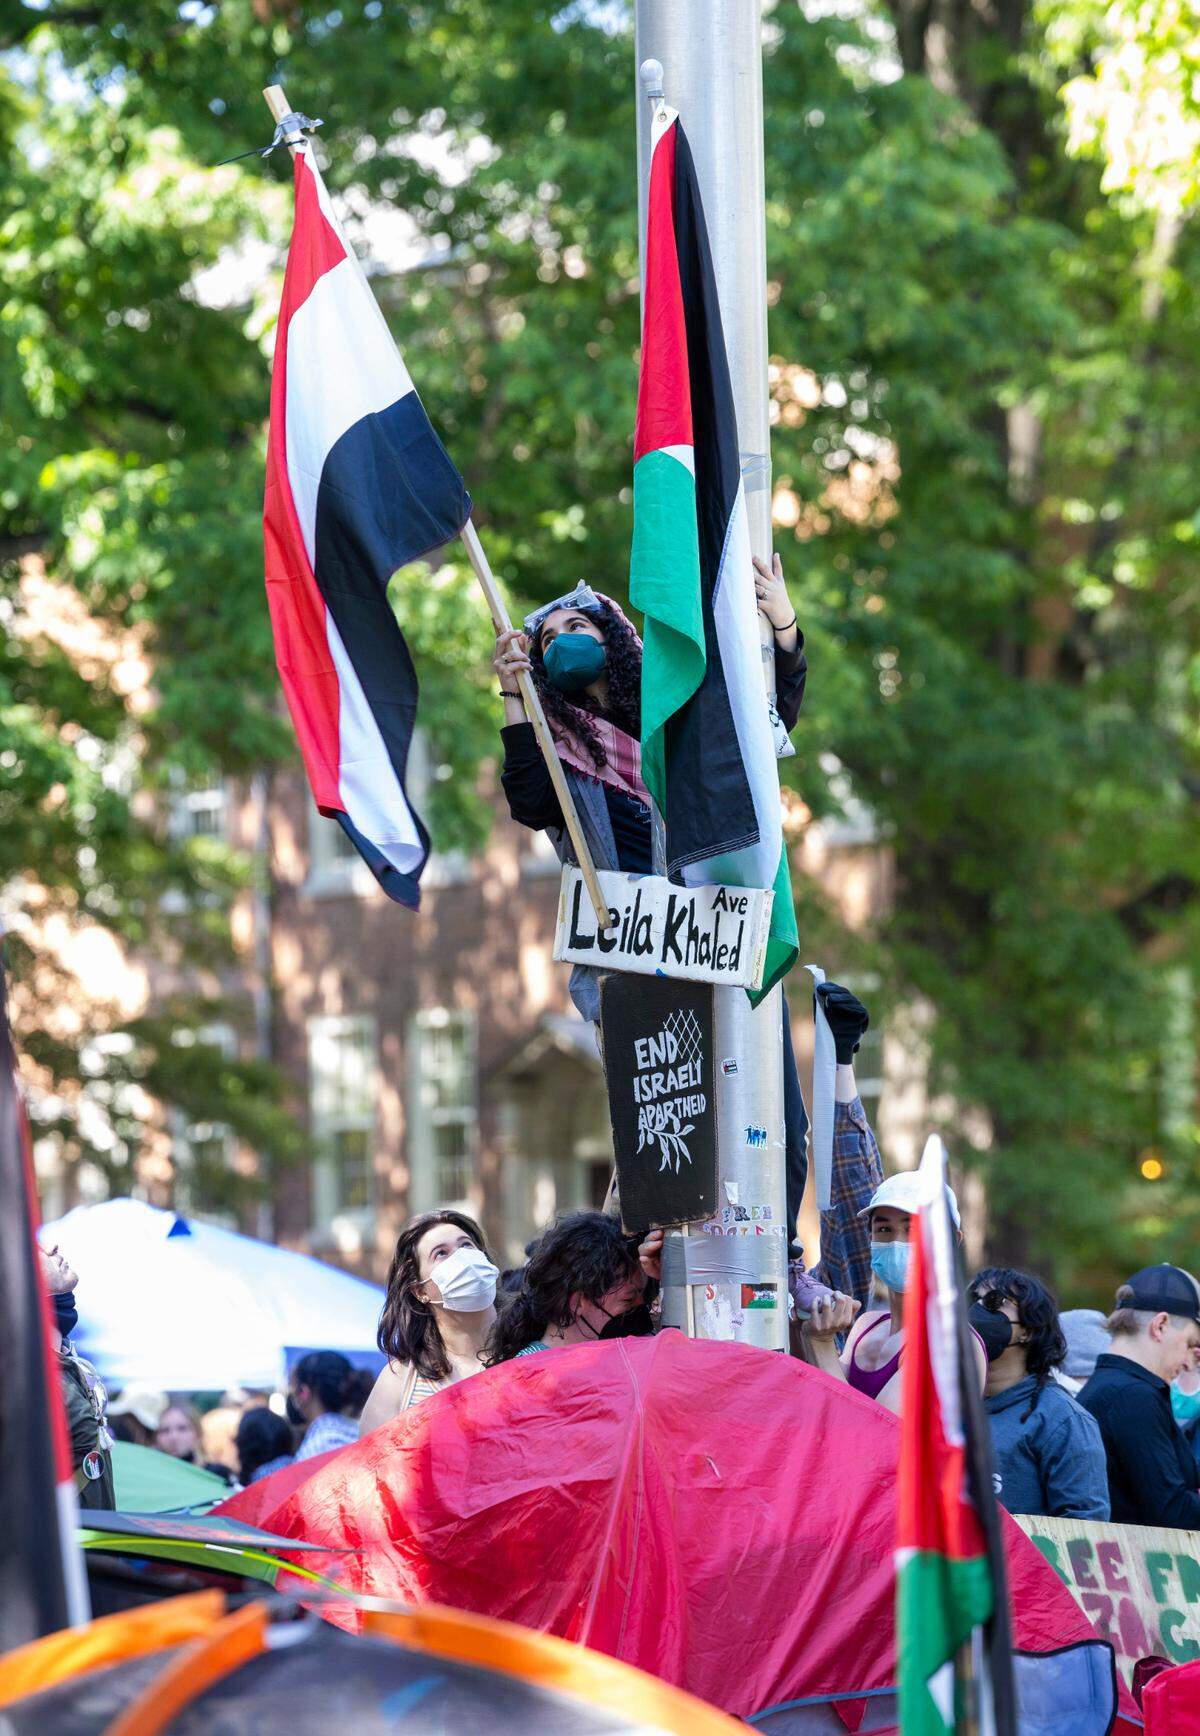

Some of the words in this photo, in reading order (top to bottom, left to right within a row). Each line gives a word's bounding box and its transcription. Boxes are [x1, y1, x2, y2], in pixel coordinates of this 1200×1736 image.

[711, 887, 748, 915] Ave
[568, 880, 654, 956] Leila
[661, 894, 744, 971] Khaled
[634, 1031, 679, 1070] END
[633, 1060, 703, 1104] ISRAELI
[638, 1093, 707, 1132] APARTHEID
